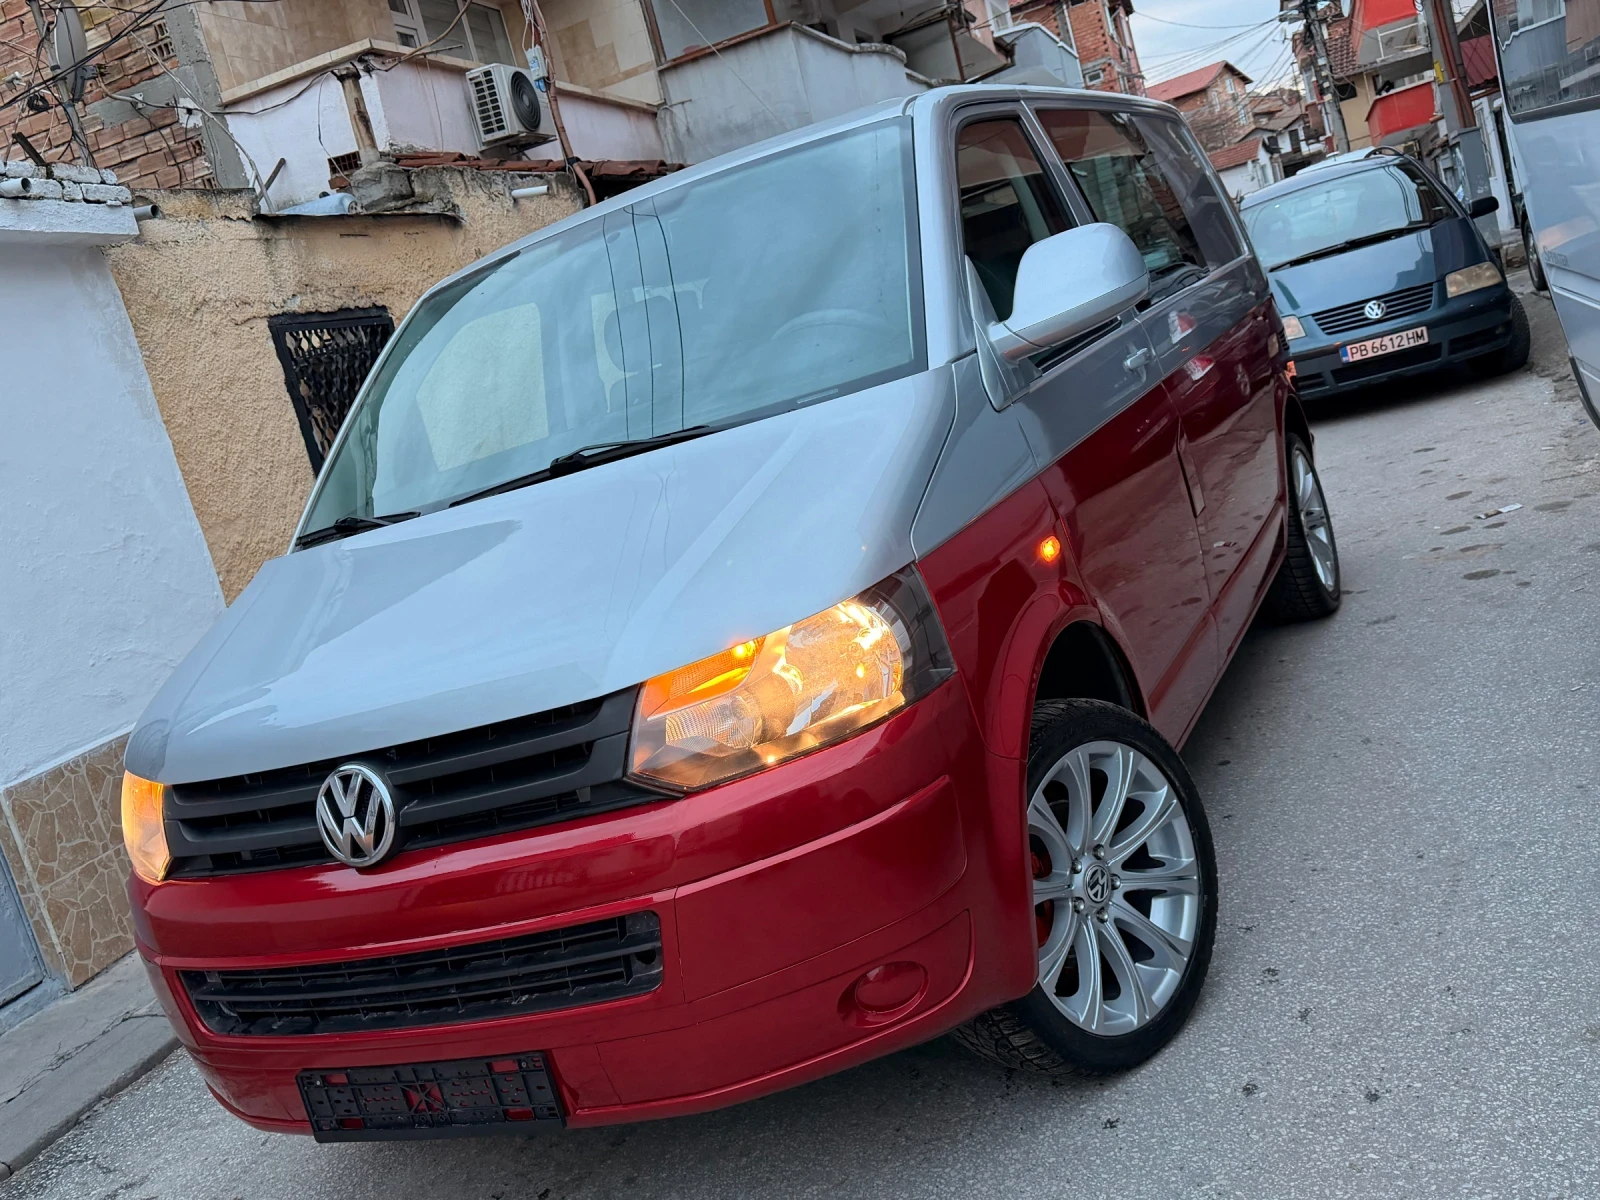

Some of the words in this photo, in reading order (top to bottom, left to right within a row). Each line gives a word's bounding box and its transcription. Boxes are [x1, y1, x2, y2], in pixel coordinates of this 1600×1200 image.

[1365, 300, 1386, 319] VW
[1349, 344, 1369, 360] PB
[1371, 335, 1405, 354] 6612
[1406, 328, 1426, 346] HM
[318, 766, 393, 865] VW
[1086, 865, 1108, 902] VW
